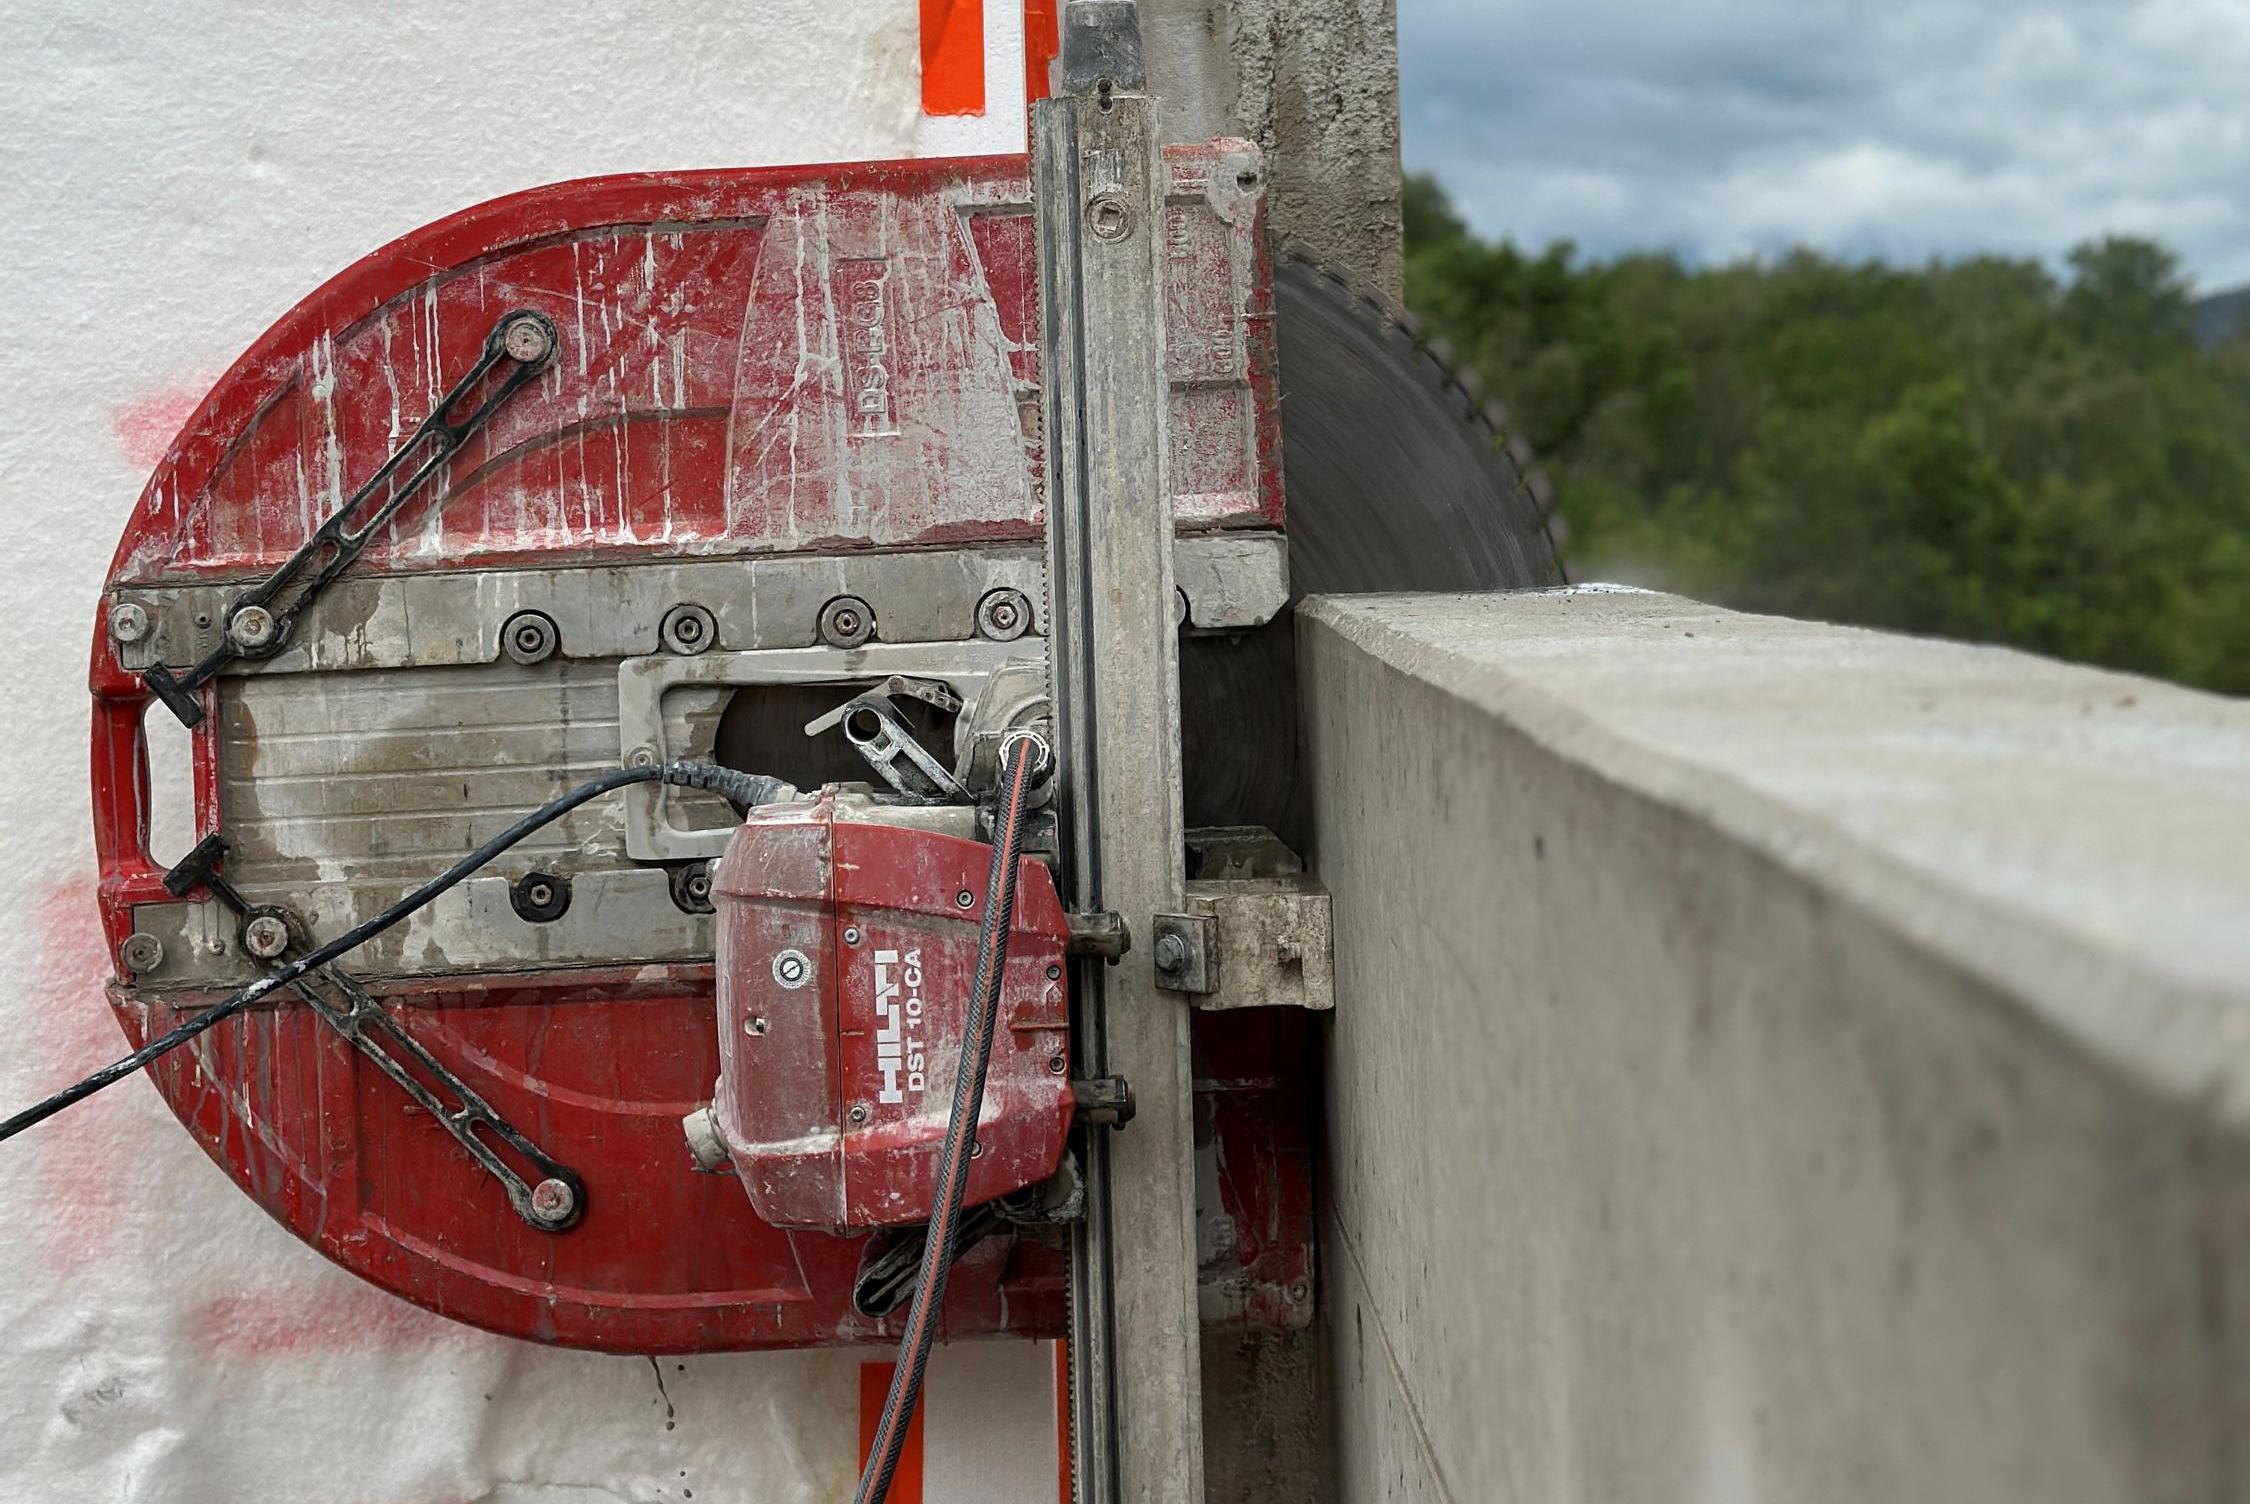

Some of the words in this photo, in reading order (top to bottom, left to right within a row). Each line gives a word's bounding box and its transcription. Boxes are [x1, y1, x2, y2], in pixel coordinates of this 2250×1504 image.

[875, 950, 903, 1104] HILTI
[904, 948, 923, 1029] 10-CA
[906, 1036, 925, 1092] DST
